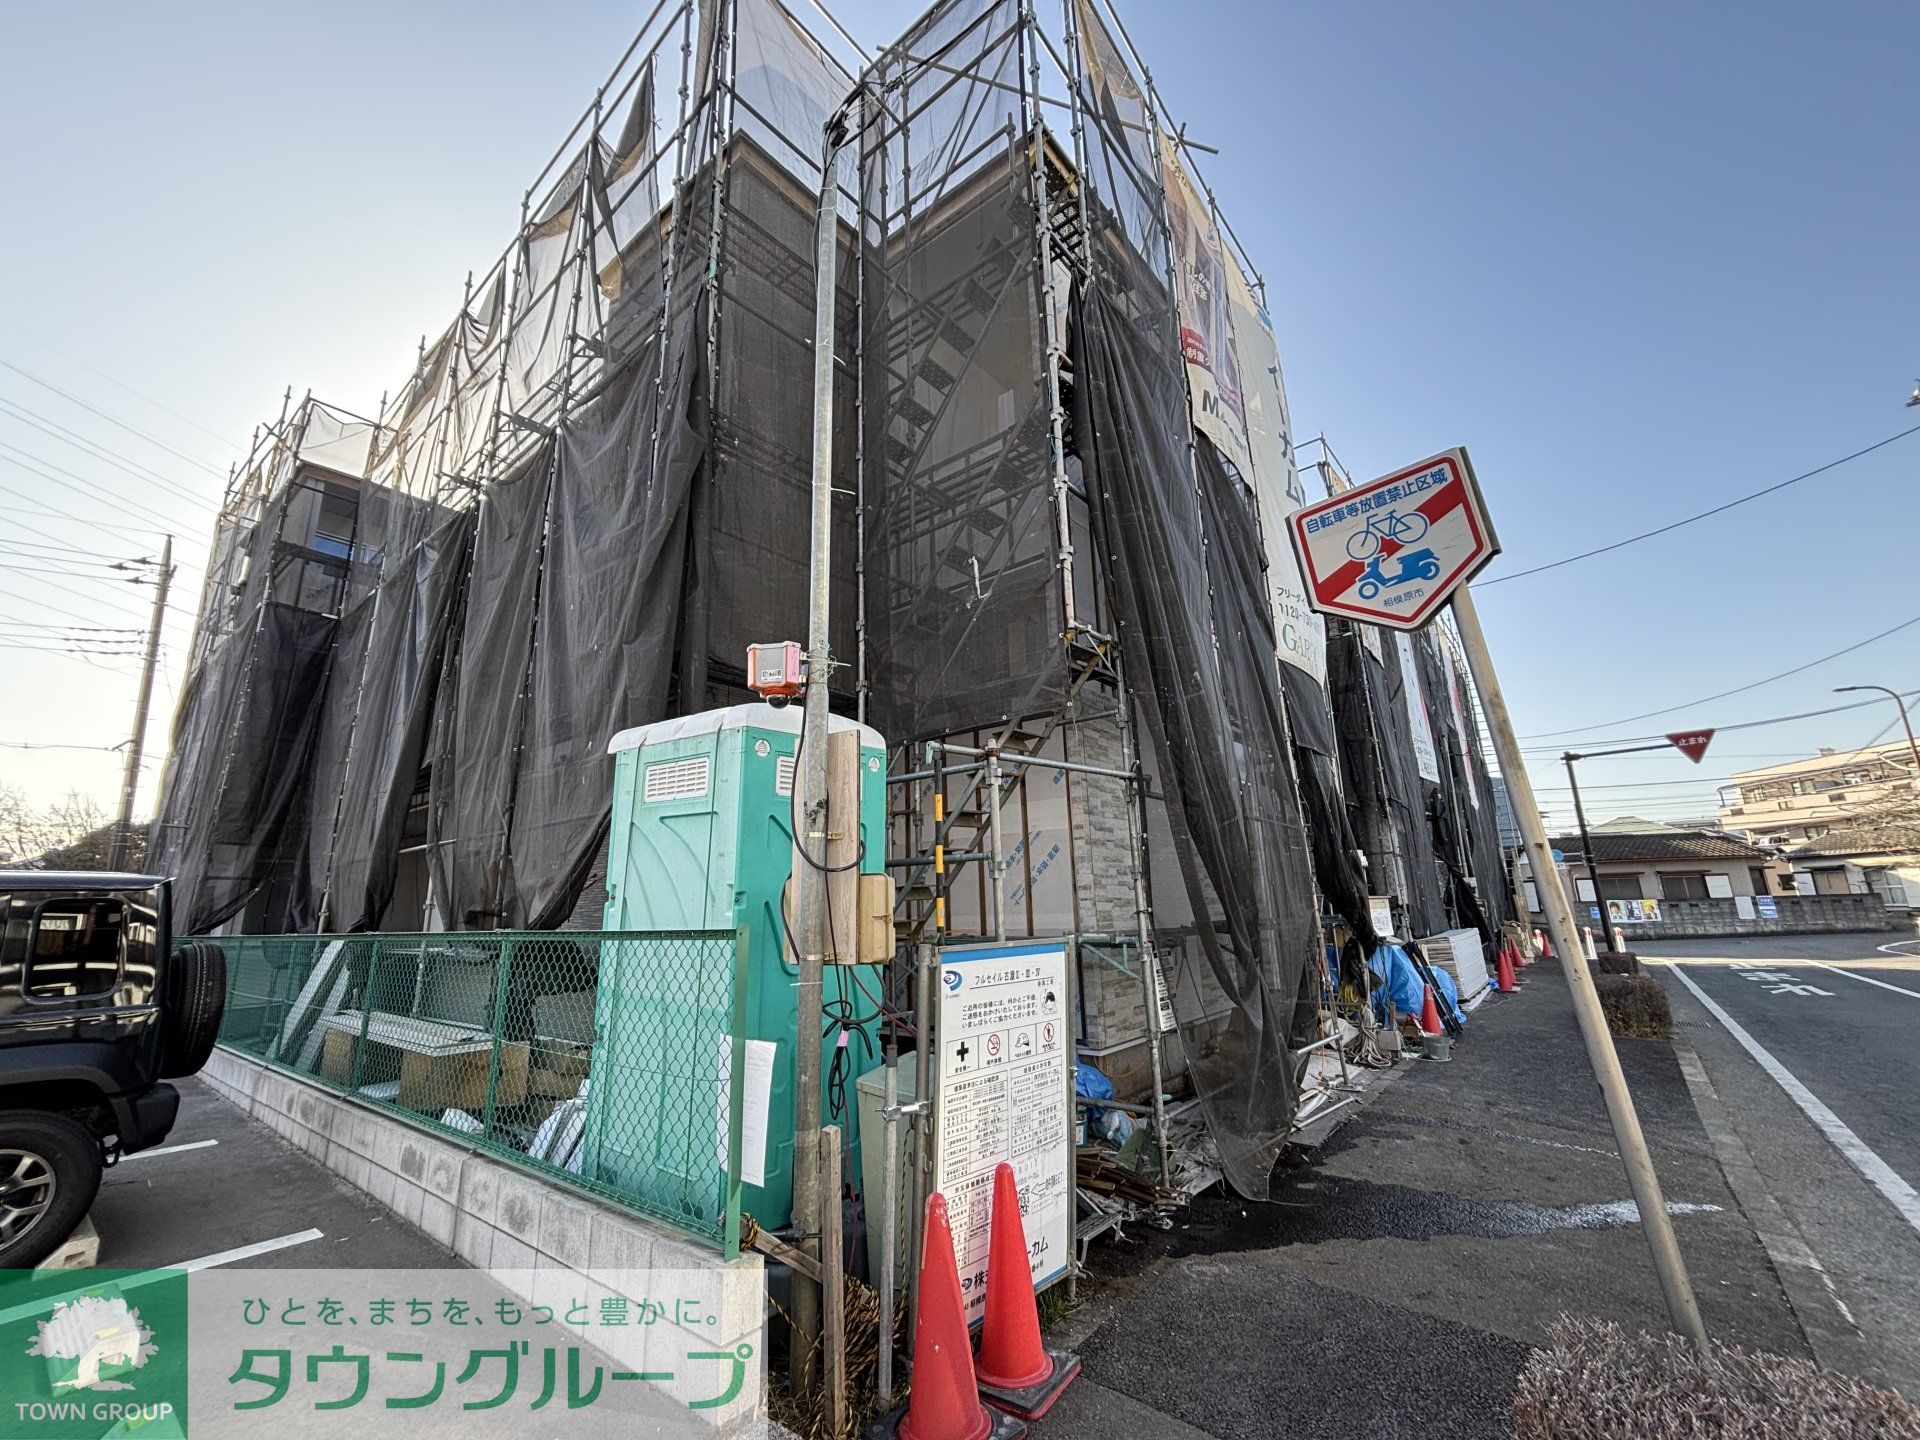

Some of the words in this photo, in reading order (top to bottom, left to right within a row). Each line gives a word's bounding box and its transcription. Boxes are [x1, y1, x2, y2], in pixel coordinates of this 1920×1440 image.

[1306, 467, 1447, 534] 自転車等放置禁止区域
[1383, 588, 1424, 608] 相模原市
[1679, 735, 1708, 747] 止まれ
[1729, 961, 1836, 996] 止まれ
